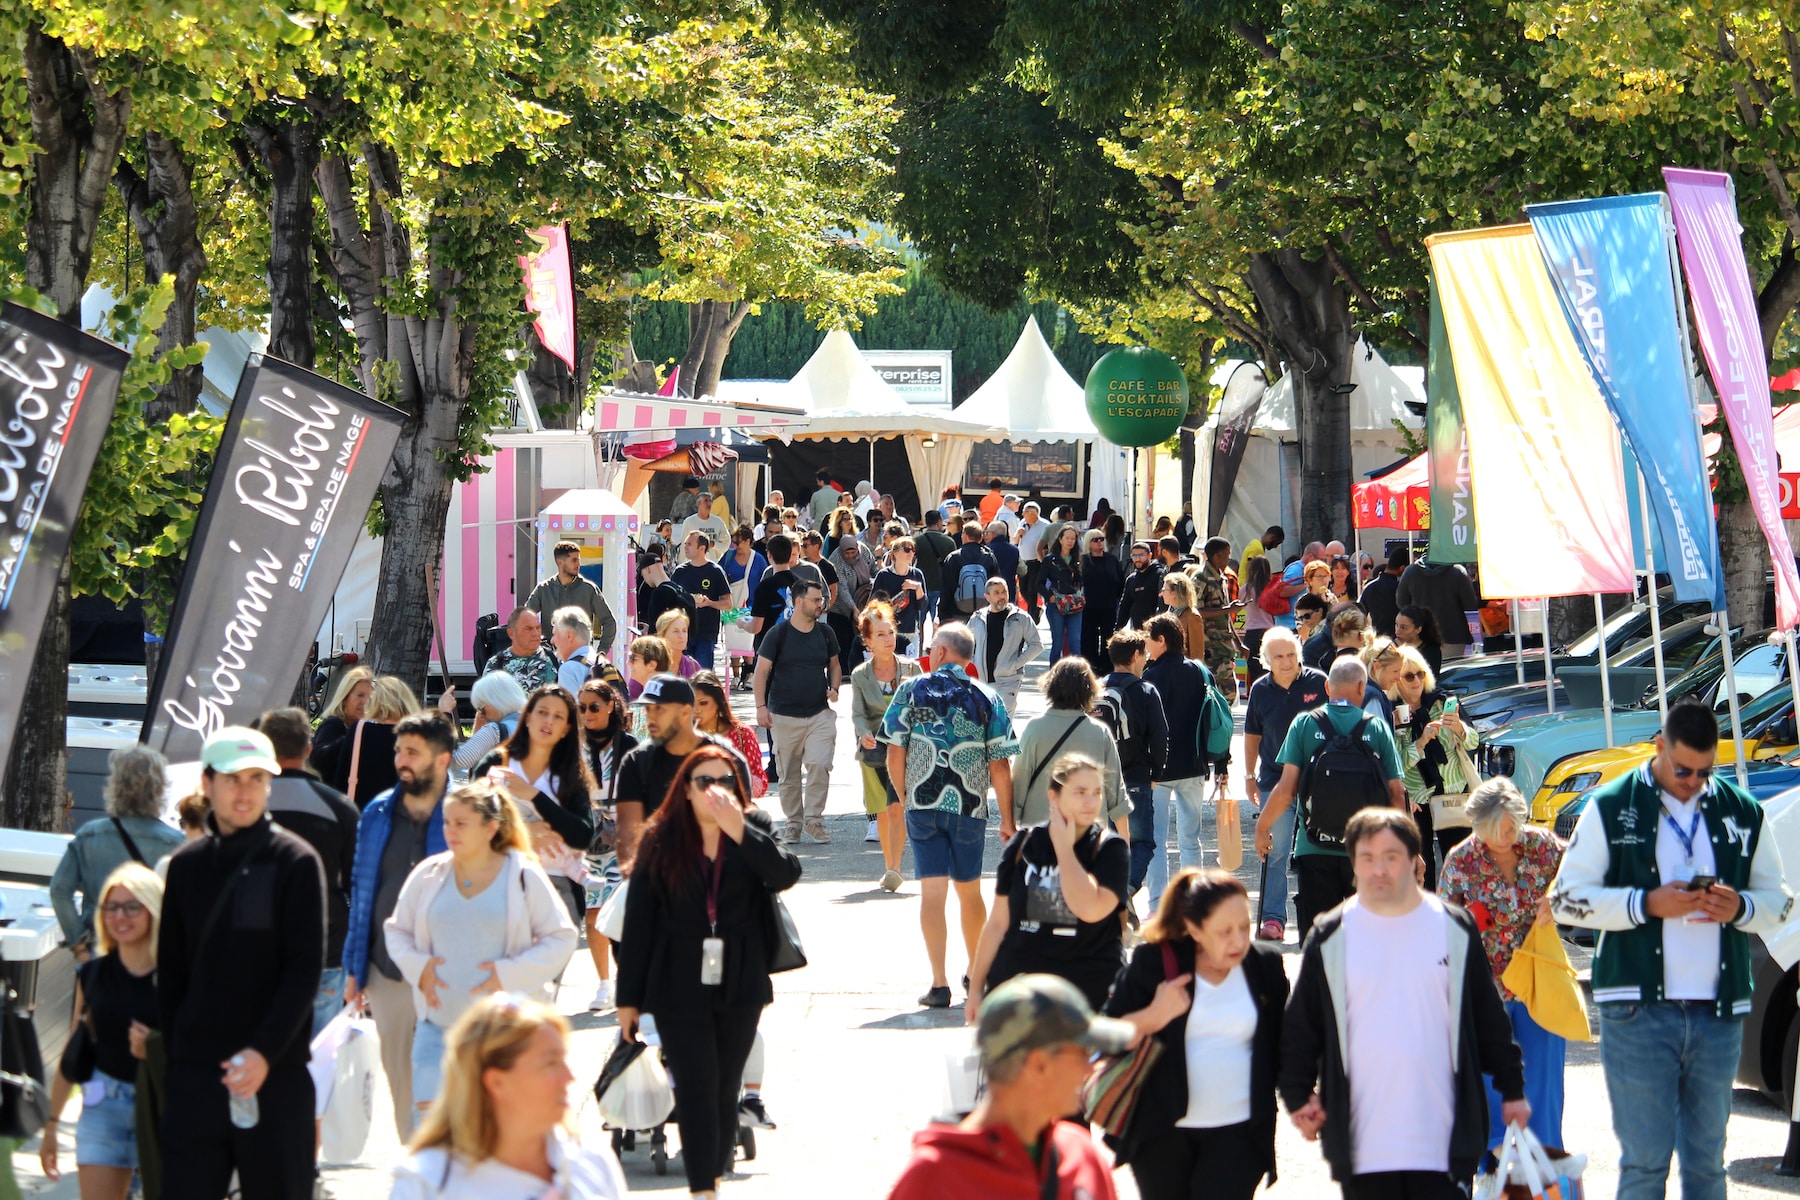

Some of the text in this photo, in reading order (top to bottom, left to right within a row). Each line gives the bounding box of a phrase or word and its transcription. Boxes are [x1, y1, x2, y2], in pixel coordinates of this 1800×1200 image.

[877, 368, 941, 382] terprise
[1109, 378, 1145, 391] CAFÉ
[1157, 381, 1181, 391] BAR
[53, 362, 89, 435] NAGE
[1107, 393, 1182, 405] COCKTAILS
[1108, 407, 1180, 418] L'ESCAPADE
[37, 438, 60, 475] DE
[17, 481, 45, 531] SPA
[288, 414, 366, 590] SPA & SPA DE NAGE
[10, 535, 25, 551] &
[164, 386, 341, 742] Giovanni Riboli
[1721, 816, 1751, 858] NY
